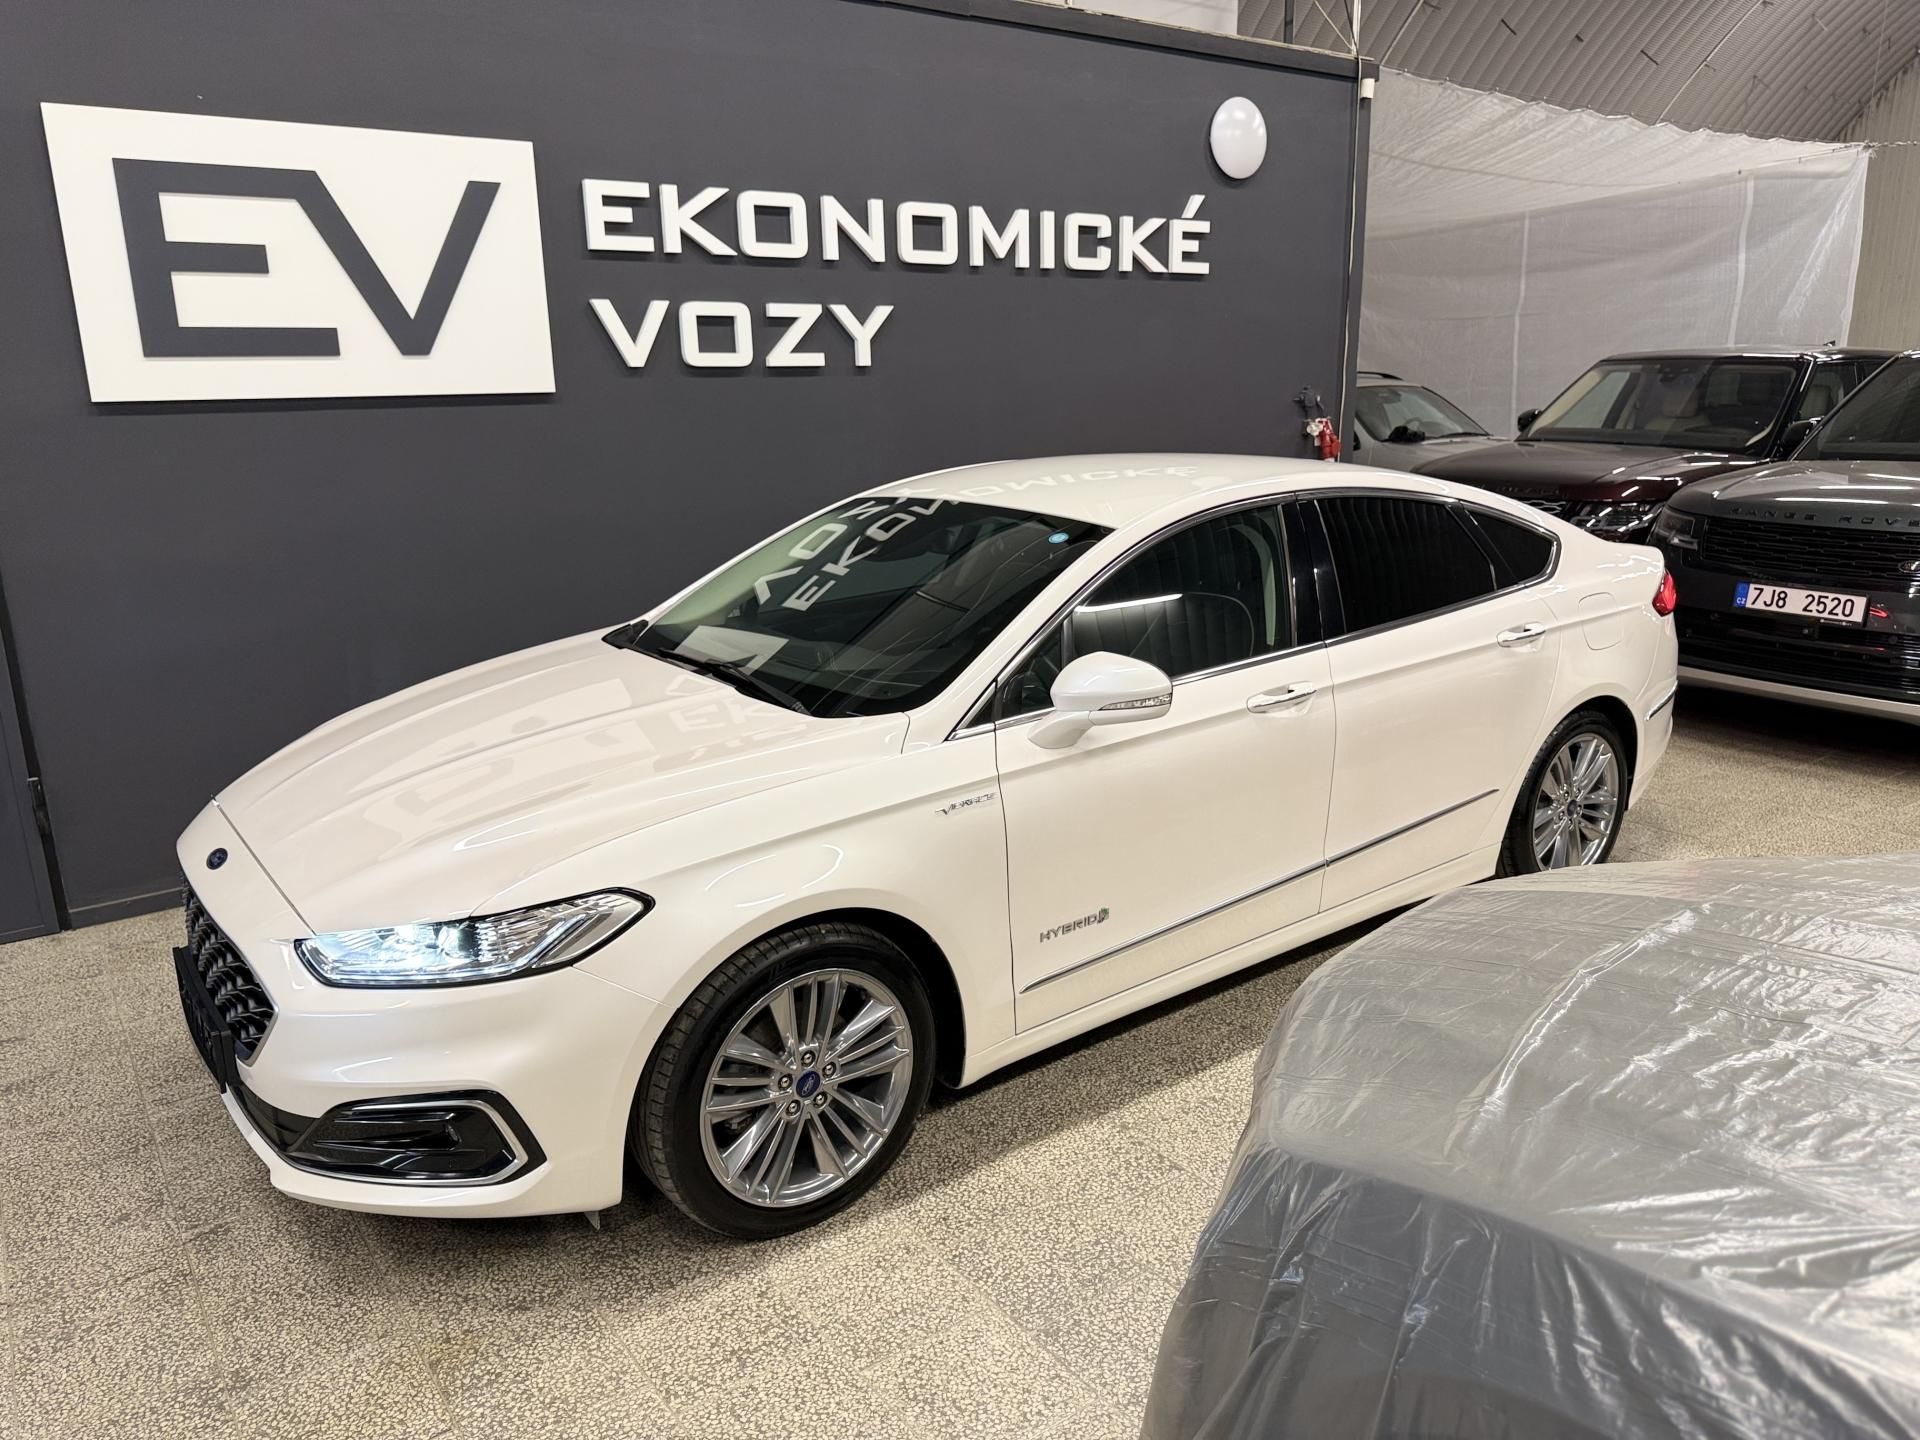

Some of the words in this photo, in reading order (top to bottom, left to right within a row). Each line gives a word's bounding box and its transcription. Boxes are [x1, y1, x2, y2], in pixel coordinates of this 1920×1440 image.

[581, 178, 1211, 275] EKONOMICKÉ
[112, 158, 500, 357] EV
[589, 298, 894, 368] VOZY
[1736, 597, 1746, 605] CZ
[1751, 587, 1788, 609] 7J8
[1802, 593, 1855, 617] 2520
[1039, 913, 1098, 943] HYBRID
